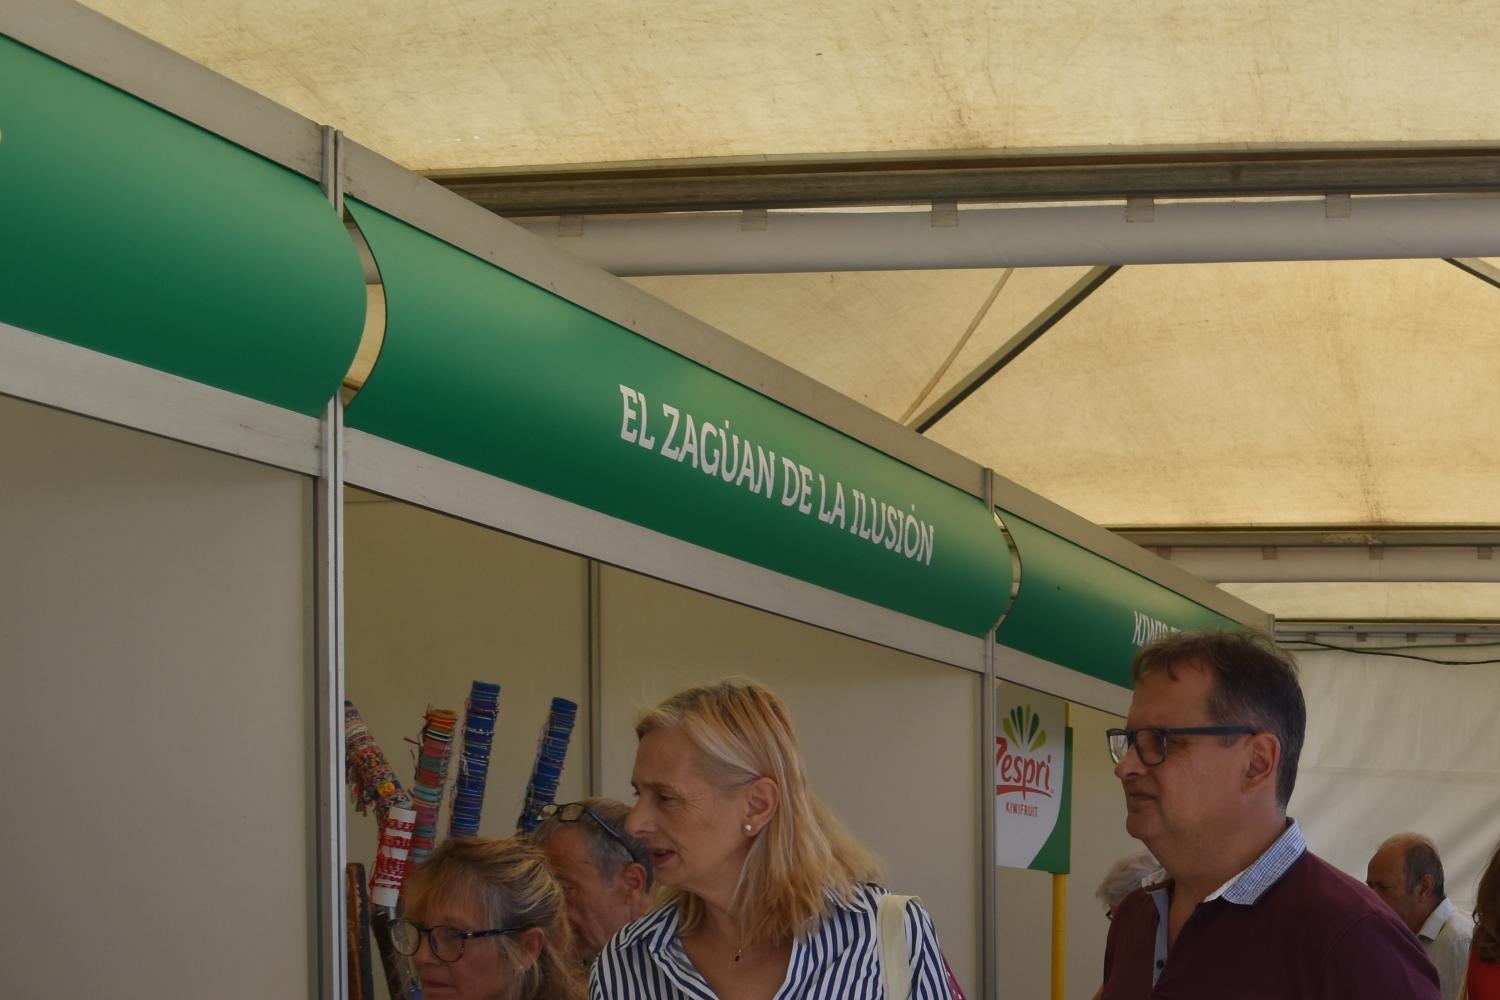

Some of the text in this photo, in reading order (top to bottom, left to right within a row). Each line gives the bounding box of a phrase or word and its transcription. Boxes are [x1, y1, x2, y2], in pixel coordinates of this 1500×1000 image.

[619, 384, 655, 450] EL
[781, 456, 813, 515] DE
[819, 473, 845, 529] LA
[850, 489, 935, 566] ILUSIÓN
[1006, 801, 1039, 817] KIWIFRUIT
